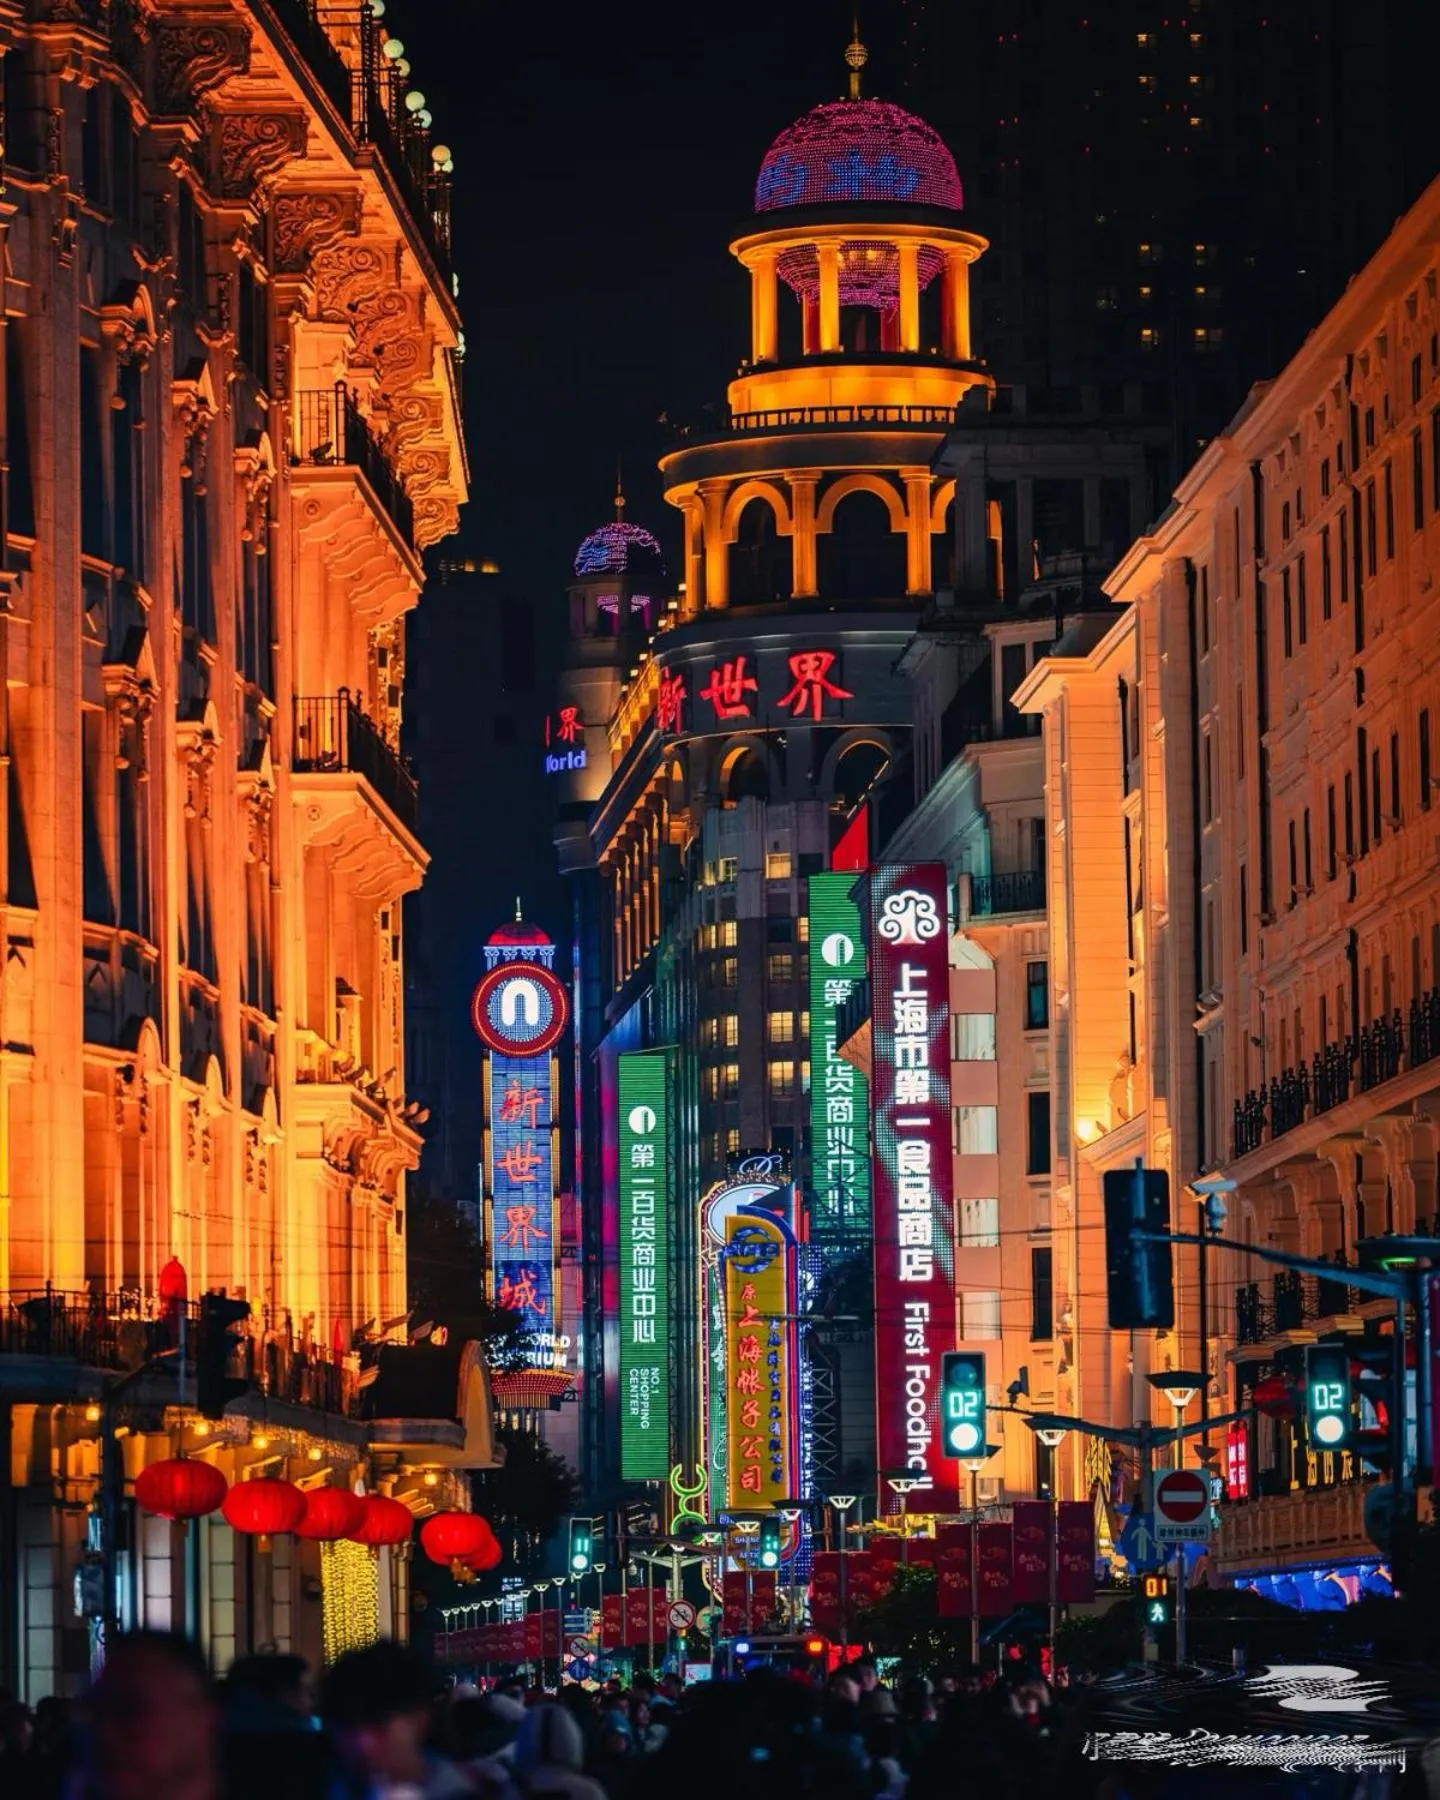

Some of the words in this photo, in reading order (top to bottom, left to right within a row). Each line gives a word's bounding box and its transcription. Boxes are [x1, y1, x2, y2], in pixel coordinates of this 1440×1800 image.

[656, 652, 854, 736] 新世界
[546, 749, 587, 774] orld
[893, 962, 933, 1281] 上海市第一食品商店
[496, 1079, 549, 1315] 新世界城
[631, 1144, 656, 1343] 第一百货商业中心
[904, 1302, 930, 1357] First
[629, 1368, 639, 1416] CENTER
[640, 1368, 650, 1430] SHOPPING
[650, 1367, 660, 1394] NO.1
[949, 1391, 978, 1418] 02
[1314, 1383, 1343, 1410] 02
[1145, 1577, 1168, 1597] 01
